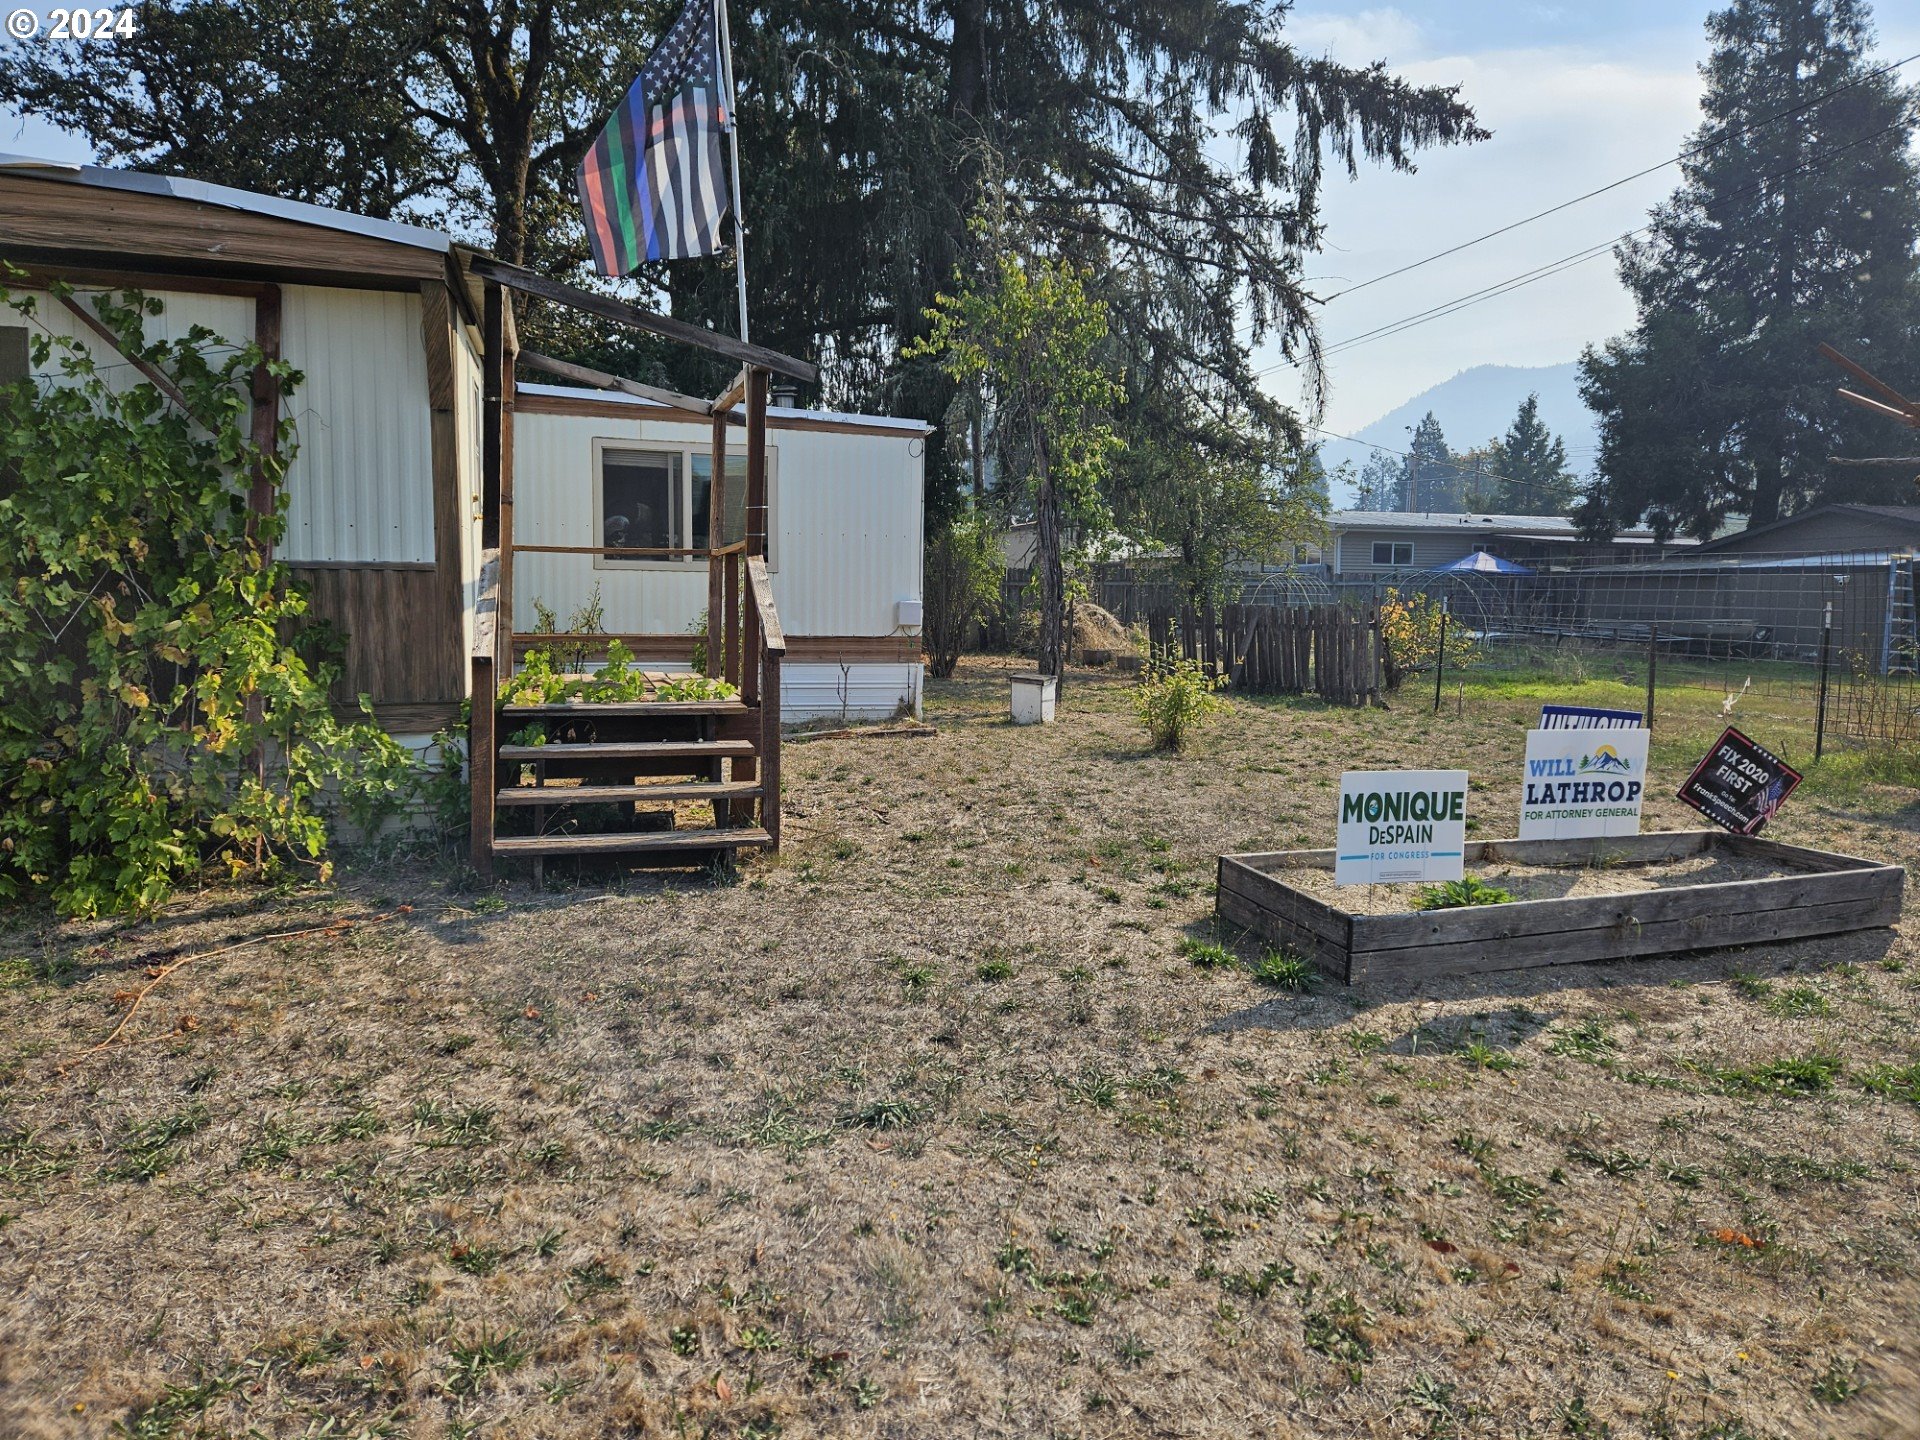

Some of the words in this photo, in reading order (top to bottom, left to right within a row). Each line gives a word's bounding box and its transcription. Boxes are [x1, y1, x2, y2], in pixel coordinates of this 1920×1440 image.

[1529, 759, 1576, 777] WILL
[1718, 745, 1741, 766] FIX
[1737, 758, 1770, 784] 2020
[1716, 764, 1753, 793] FIRST
[1526, 781, 1641, 805] LATHROP
[1693, 782, 1750, 824] FrankSpeech.com
[1342, 791, 1465, 824] MONIQUE
[1525, 810, 1543, 820] FOR
[1545, 808, 1594, 819] ATTORNEY
[1595, 807, 1639, 818] GENERAL
[1370, 852, 1385, 861] FOR
[1388, 850, 1430, 860] CONGRESS
